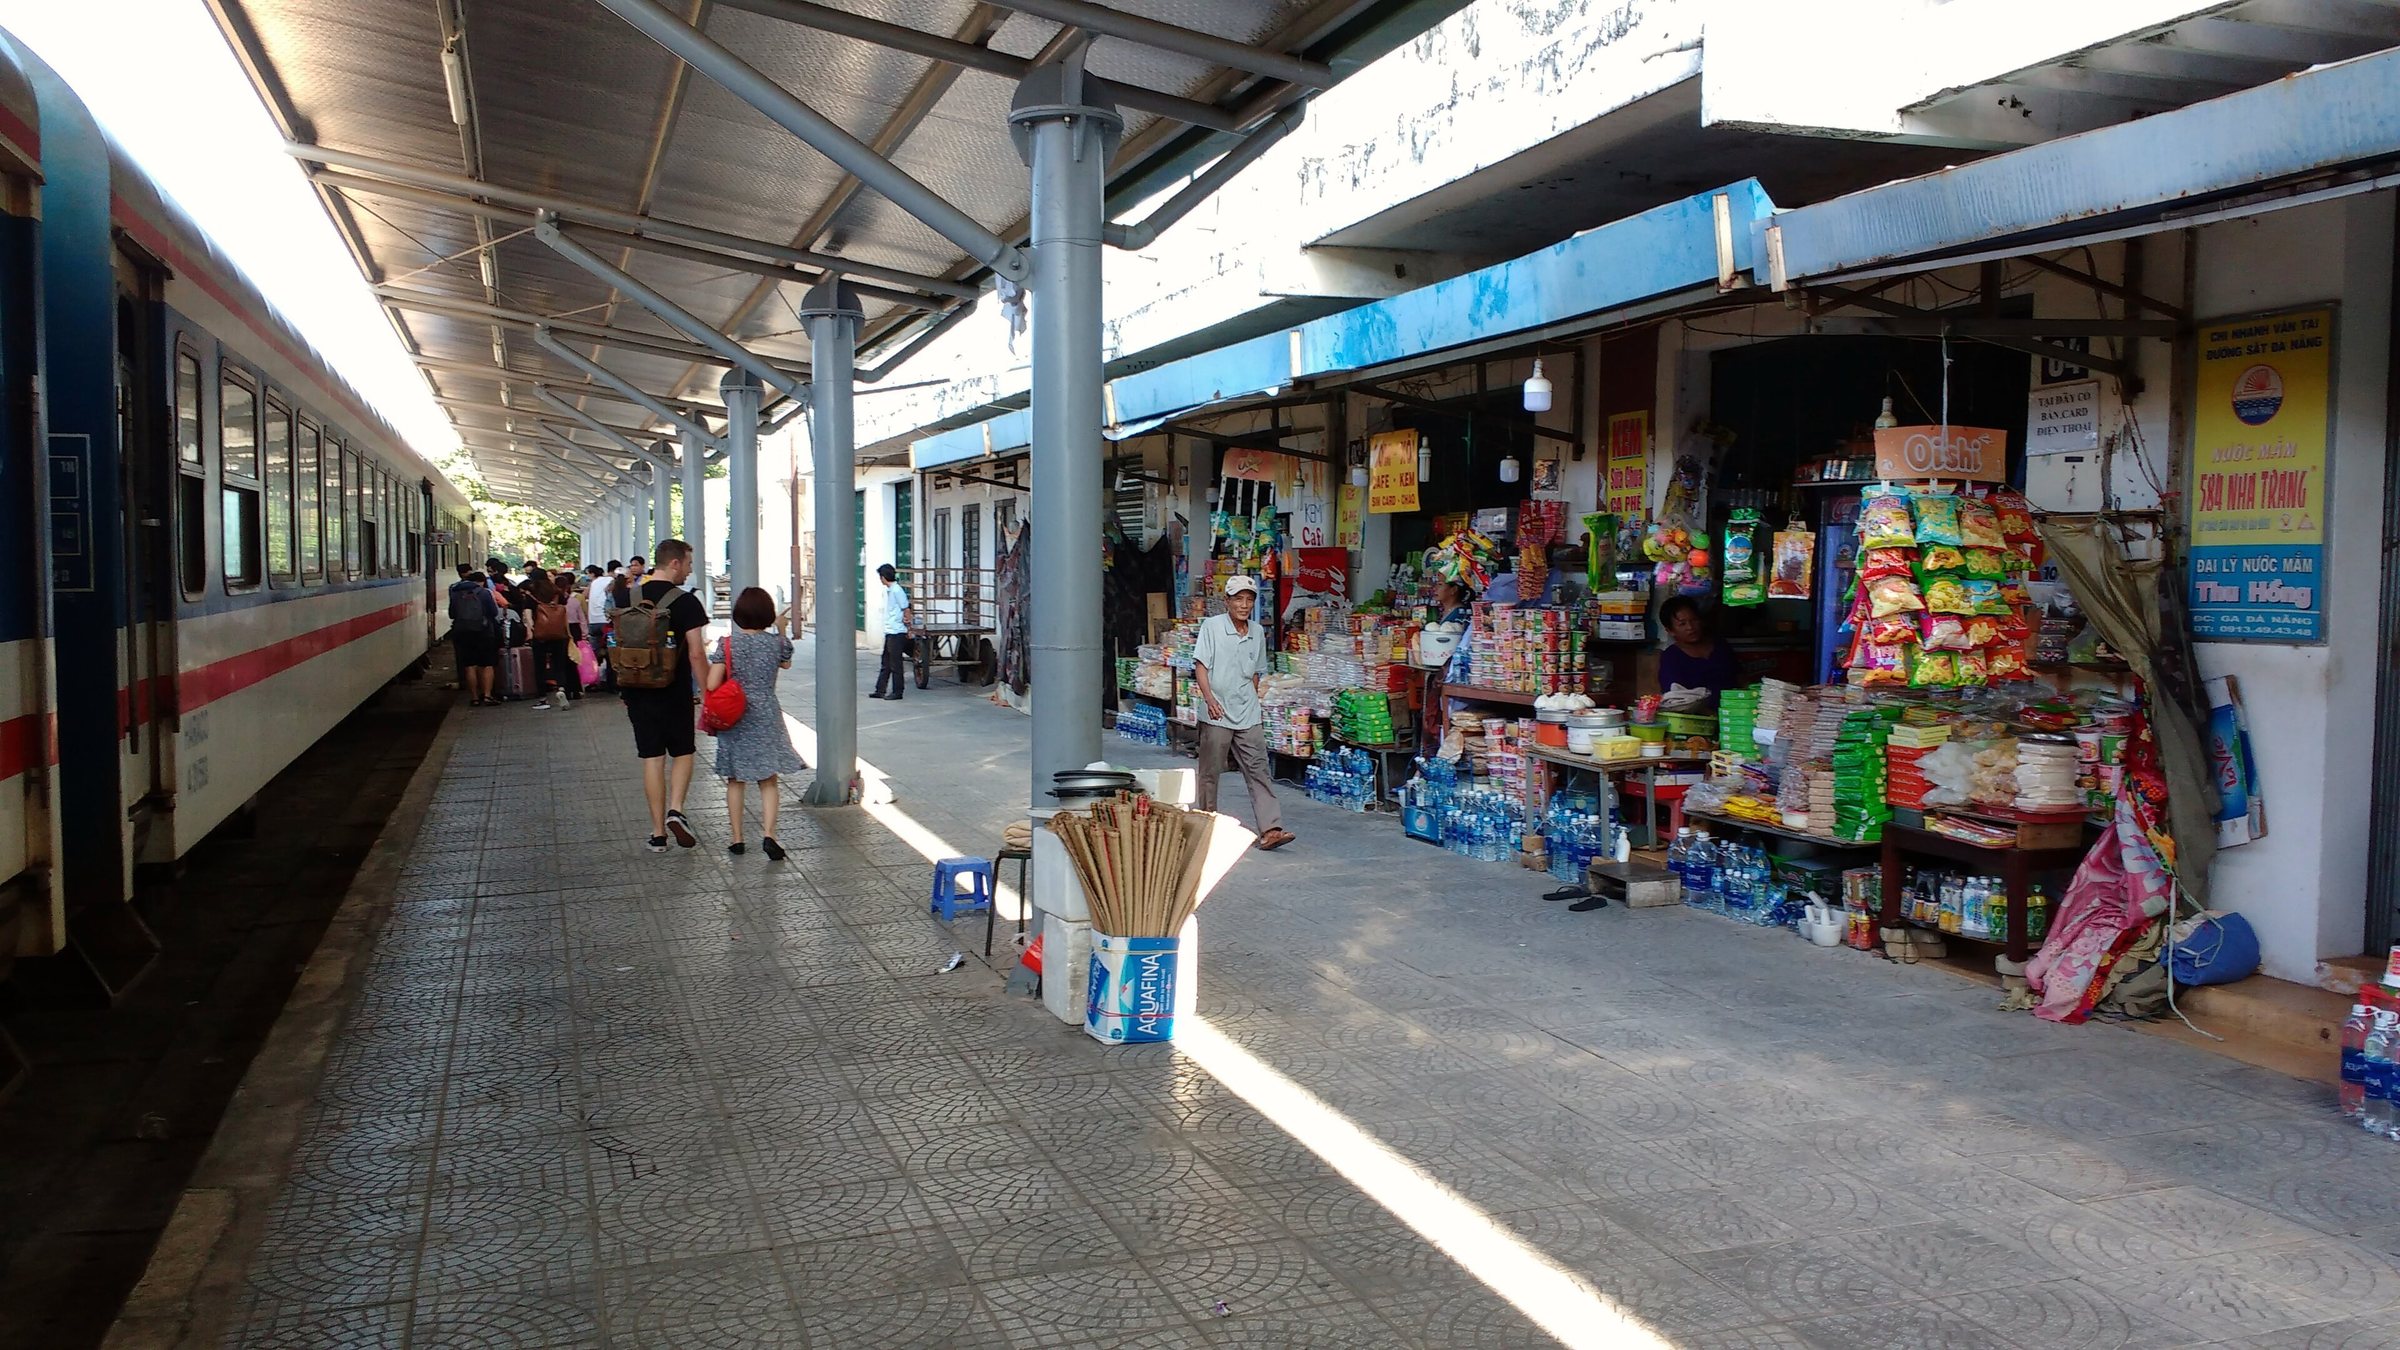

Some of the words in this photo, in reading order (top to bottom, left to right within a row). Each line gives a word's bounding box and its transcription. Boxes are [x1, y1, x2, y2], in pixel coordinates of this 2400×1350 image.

[1904, 434, 1983, 473] Oishi
[2199, 472, 2224, 512] 584
[2227, 472, 2257, 510] NHA
[2260, 469, 2308, 509] TRANG
[1302, 527, 1324, 546] Caf
[2195, 581, 2240, 603] Thu
[2220, 615, 2240, 623] GA
[1137, 953, 1163, 1035] AQUAFINA
